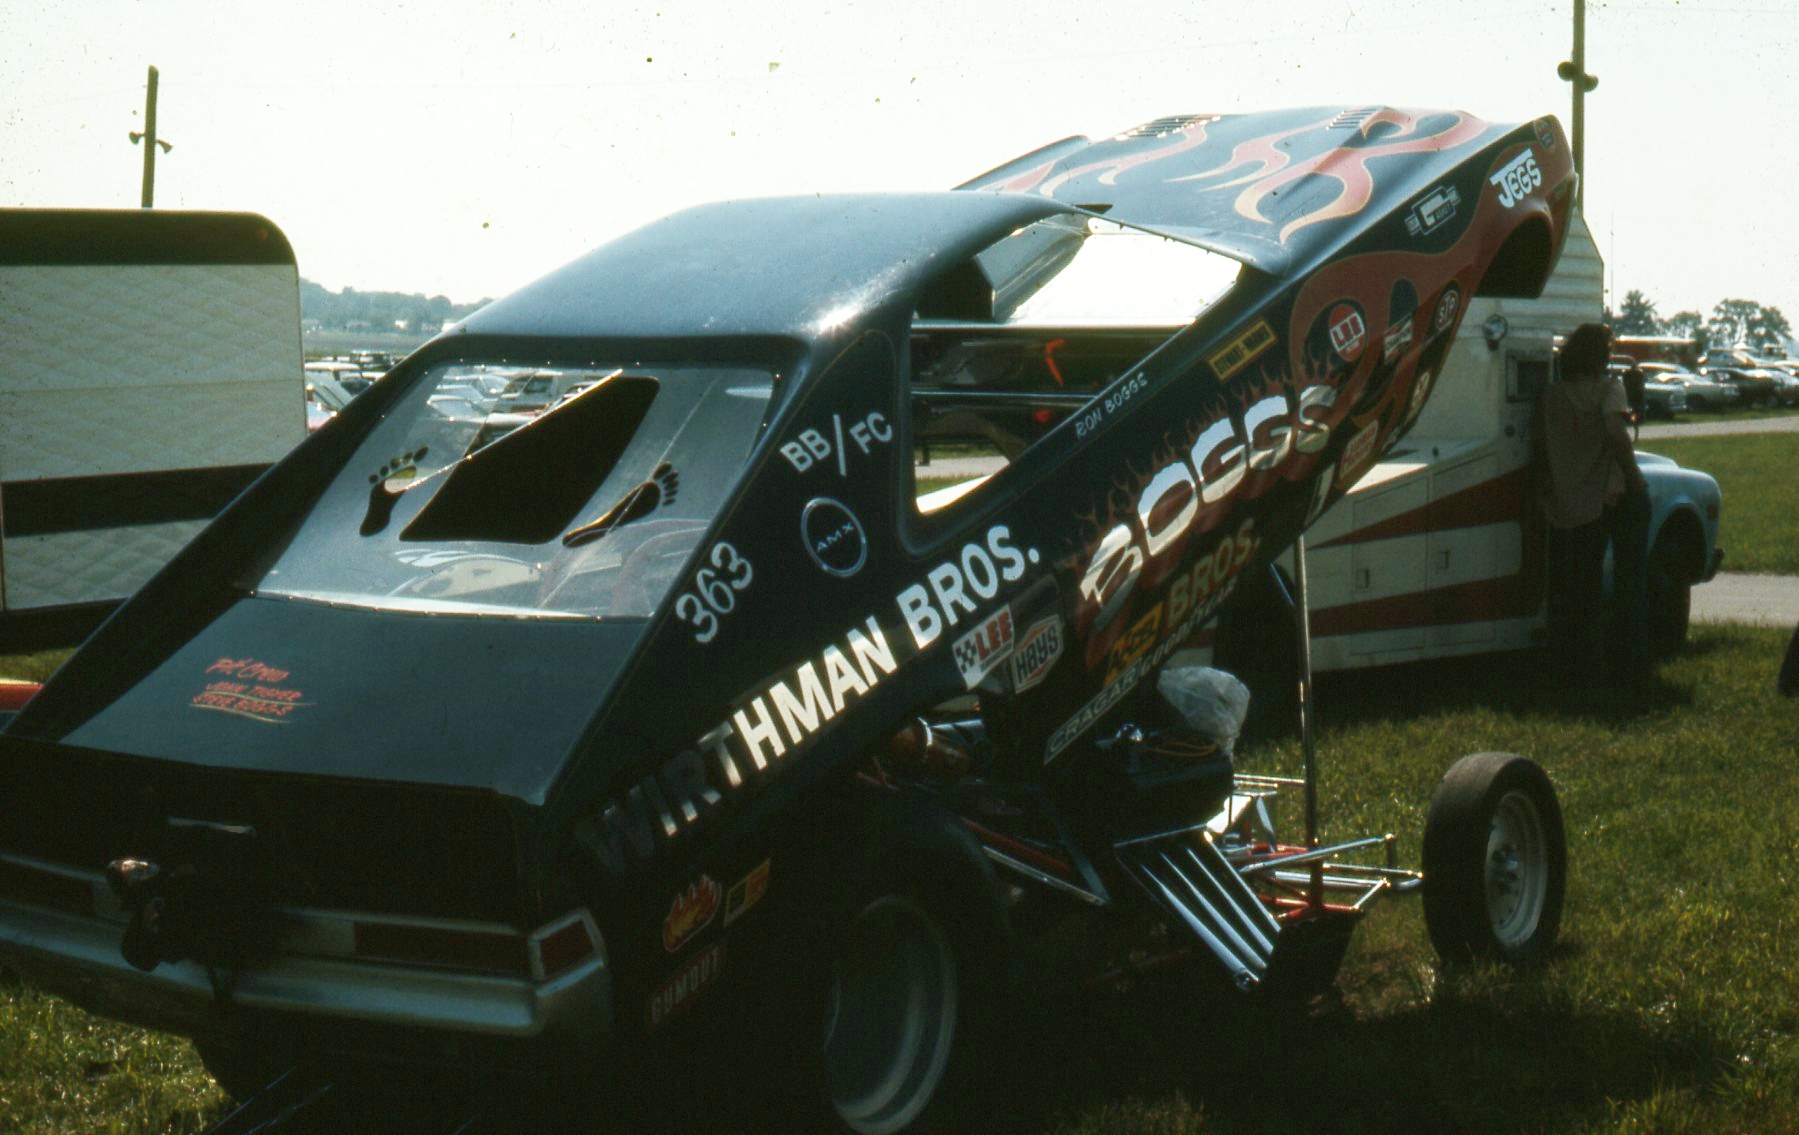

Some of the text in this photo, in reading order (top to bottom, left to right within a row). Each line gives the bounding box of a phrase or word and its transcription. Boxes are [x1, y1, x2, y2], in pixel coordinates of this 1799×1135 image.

[779, 411, 894, 478] BB/FC
[1074, 411, 1103, 440] RON
[817, 521, 855, 553] AMX
[1079, 384, 1338, 632] BOGGS
[675, 540, 754, 644] 363
[974, 611, 1013, 660] LEE
[577, 614, 899, 874] WIRTHMAN
[896, 523, 1041, 650] BROS.
